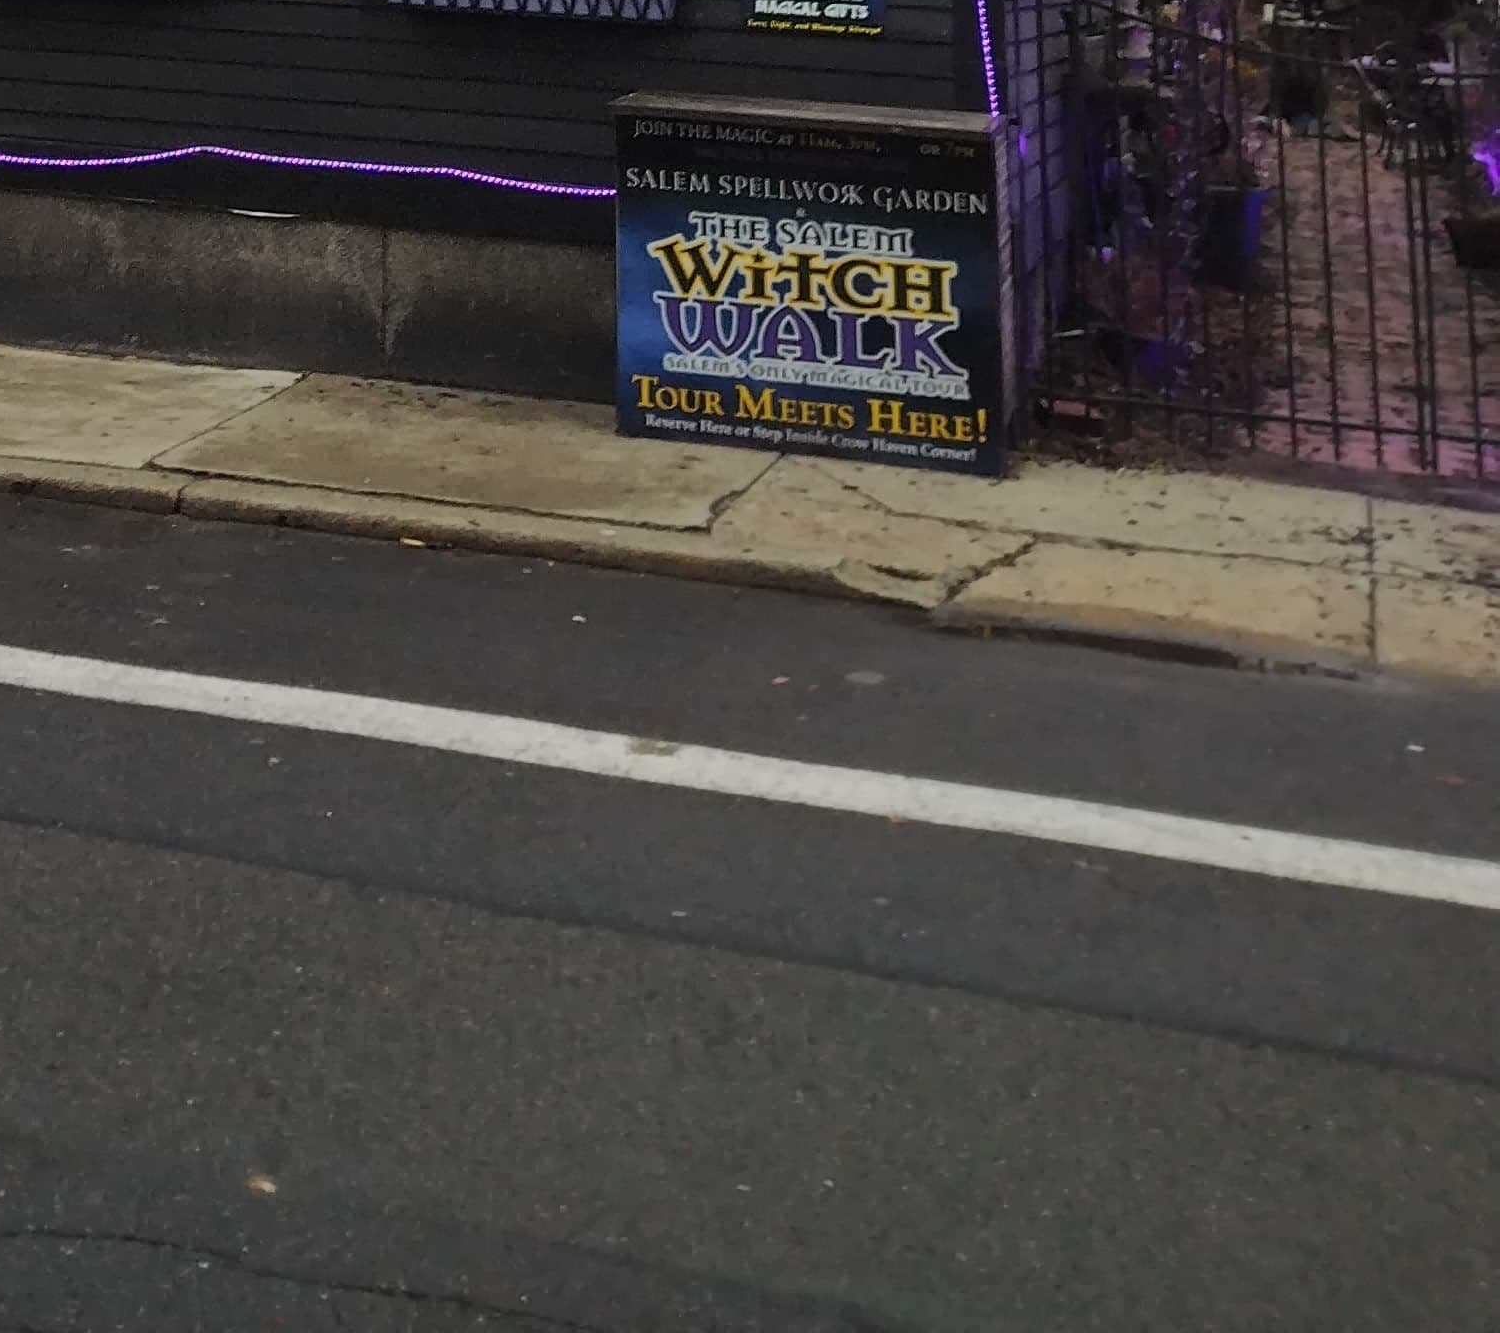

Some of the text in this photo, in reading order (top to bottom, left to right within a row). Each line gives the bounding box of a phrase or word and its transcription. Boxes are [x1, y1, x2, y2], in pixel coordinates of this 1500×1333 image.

[755, 0, 869, 19] MAGICAL GIFTS
[632, 119, 673, 138] JOIN
[674, 122, 712, 140] THE
[715, 125, 773, 144] MAGIC
[626, 167, 712, 194] SALEM
[873, 185, 988, 215] GARDEN
[691, 212, 915, 255] THE SALEM
[655, 293, 968, 379] WALK
[665, 355, 967, 399] SALEM'S ONLY MAGICAL TOUR
[632, 374, 988, 444] TOUR MEETS HERE!
[645, 413, 698, 432] Reserve
[700, 419, 732, 434] Here
[734, 426, 750, 435] or
[831, 433, 869, 450] Crow
[873, 437, 918, 455] Haven
